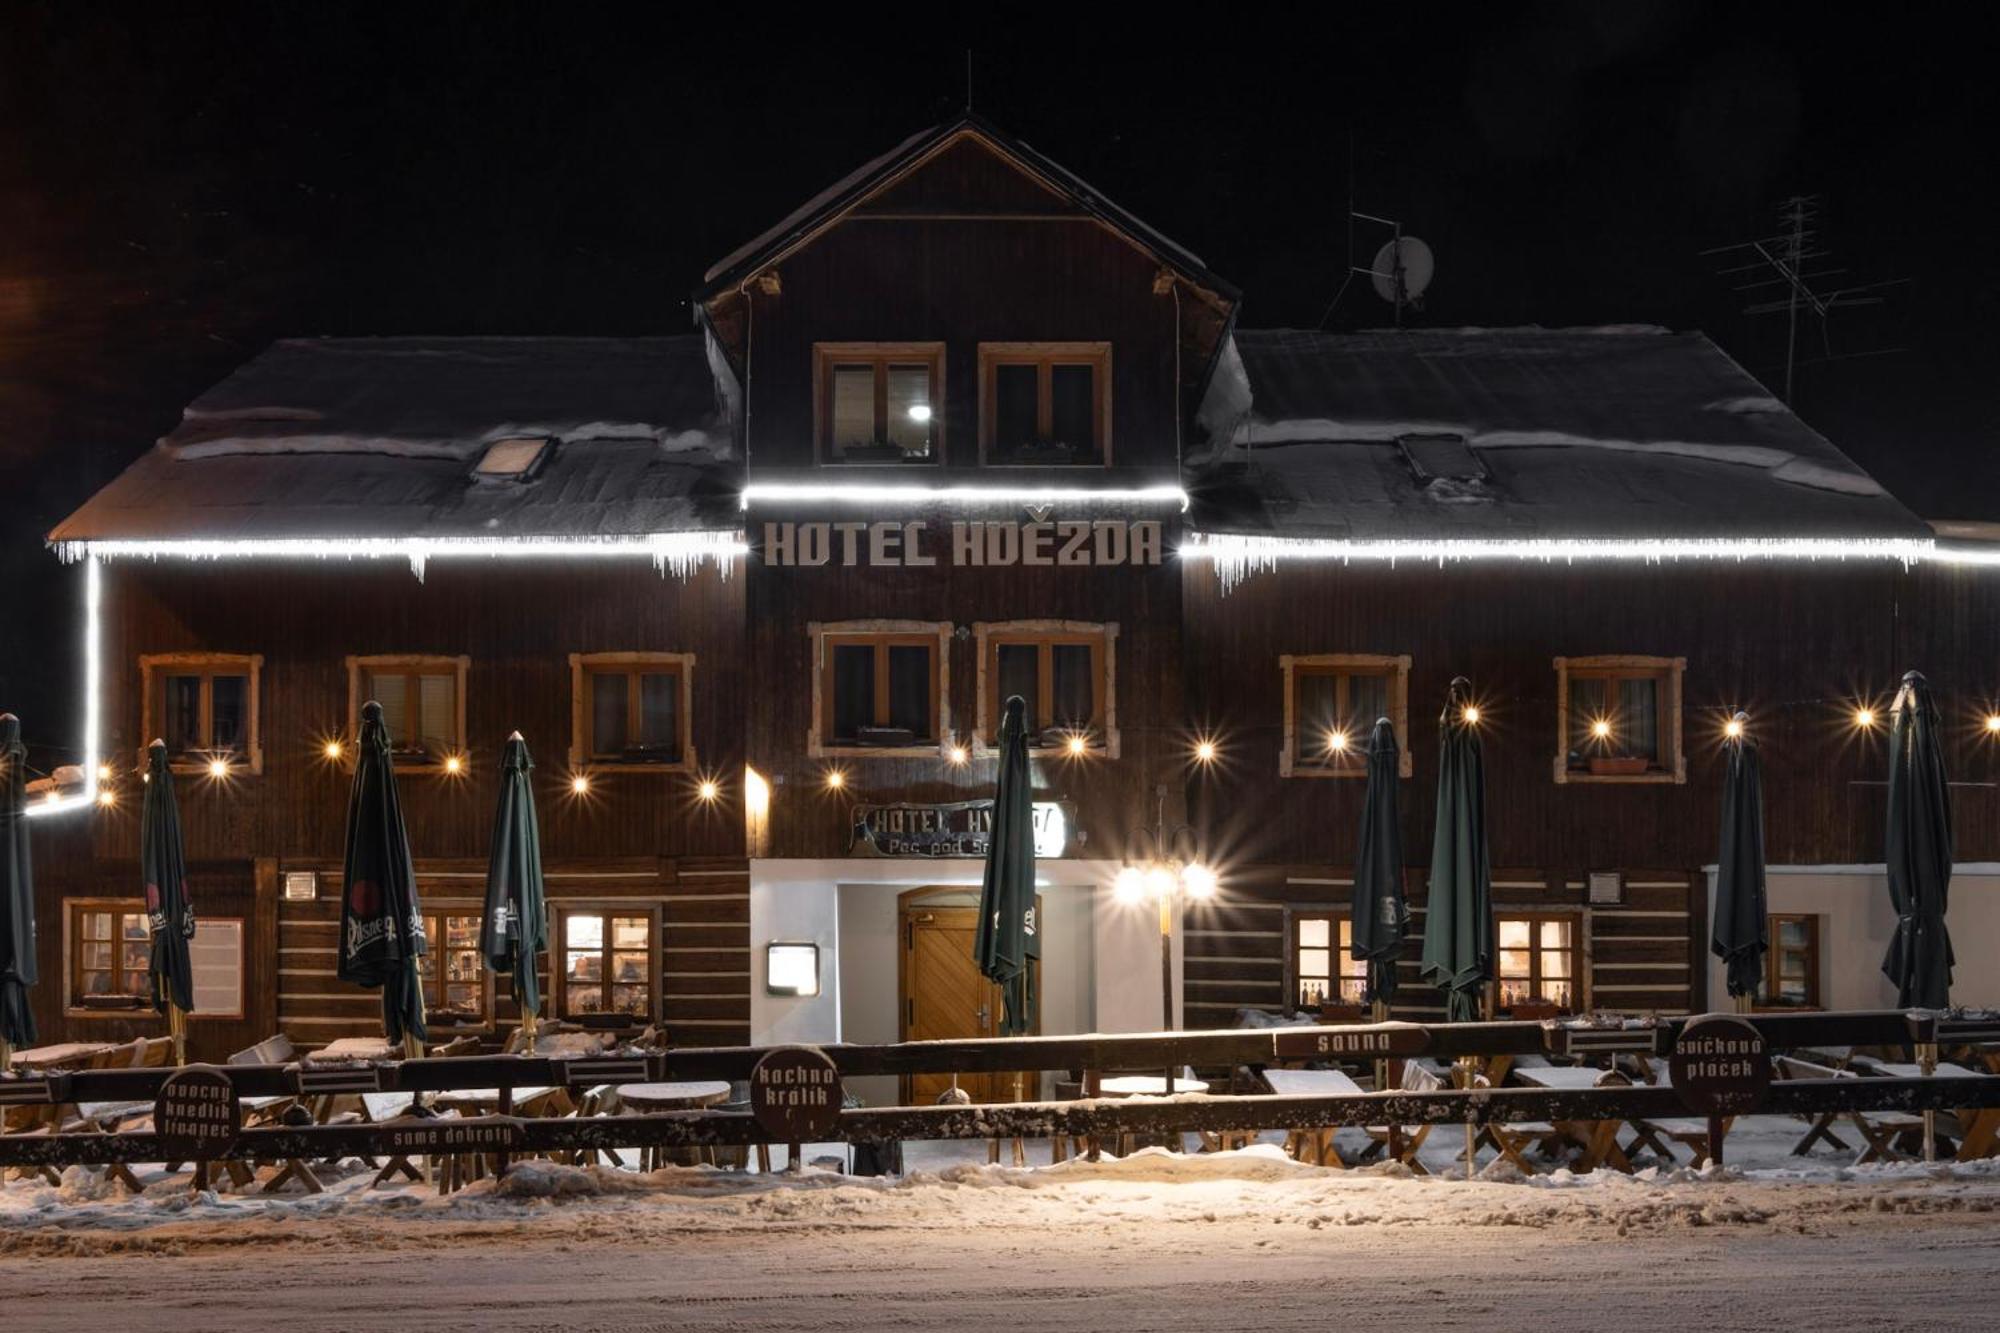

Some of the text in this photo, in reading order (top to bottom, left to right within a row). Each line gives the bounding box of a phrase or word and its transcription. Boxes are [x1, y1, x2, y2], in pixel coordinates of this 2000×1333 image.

[764, 521, 937, 566] HOTEL
[874, 809, 950, 833] HOTEL
[889, 838, 921, 854] Pec
[930, 837, 962, 857] pod
[1317, 1033, 1390, 1053] sauna
[759, 1065, 834, 1085] kachna
[765, 1085, 828, 1106] králík
